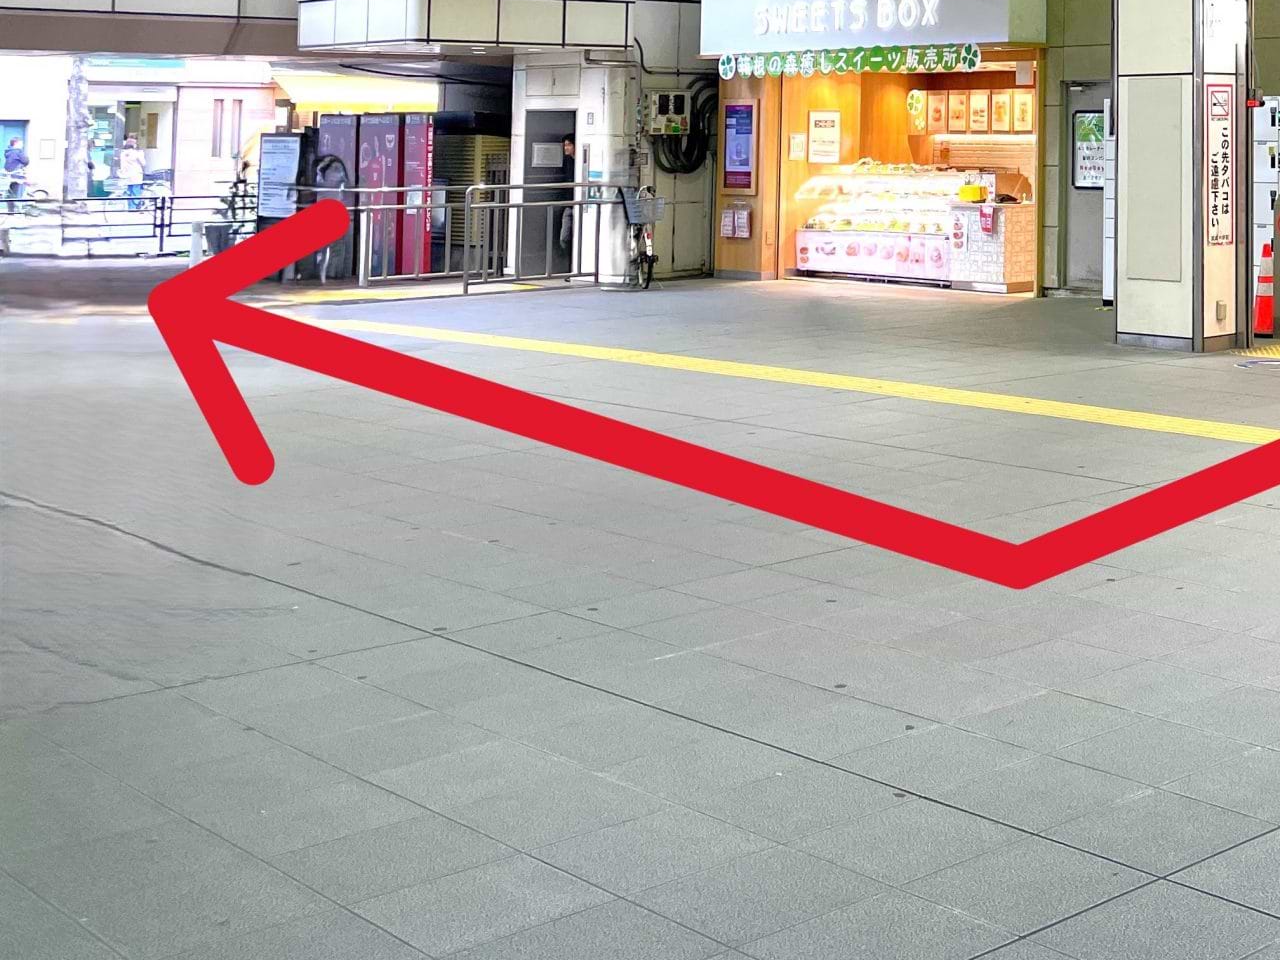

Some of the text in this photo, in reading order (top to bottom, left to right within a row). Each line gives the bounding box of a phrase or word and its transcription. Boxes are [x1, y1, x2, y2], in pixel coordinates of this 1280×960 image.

[1210, 151, 1220, 228] ご遠慮下さい
[1221, 127, 1230, 215] この先タバコは
